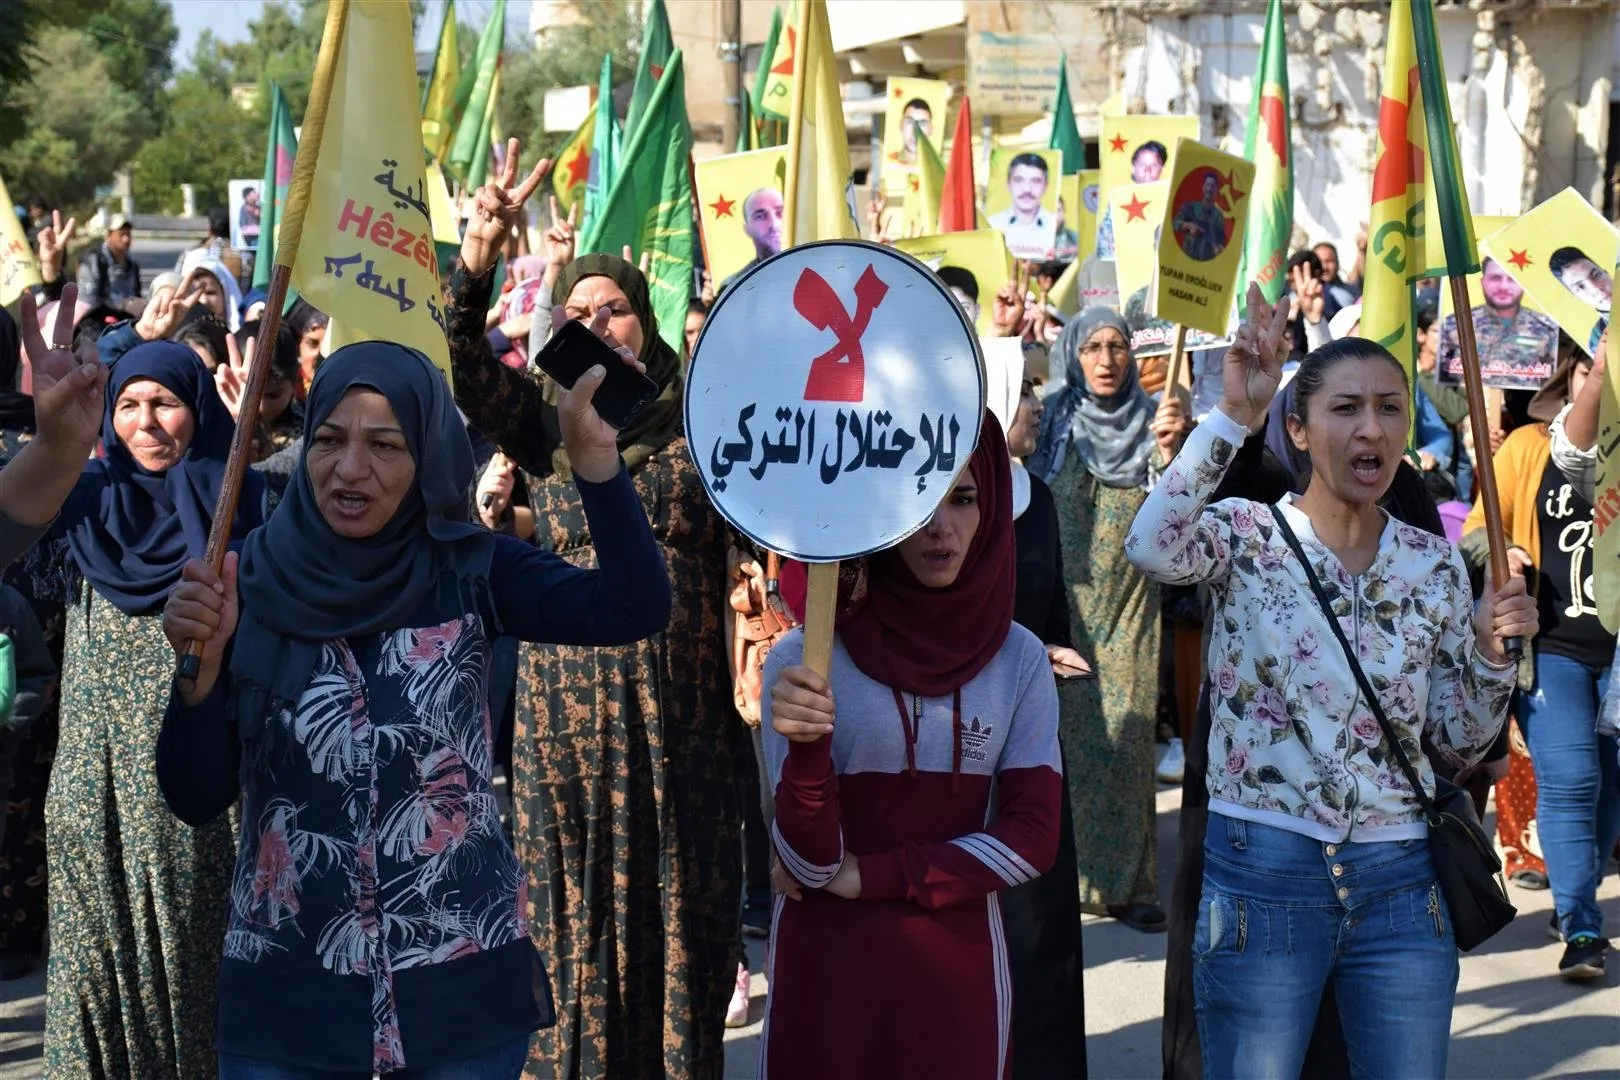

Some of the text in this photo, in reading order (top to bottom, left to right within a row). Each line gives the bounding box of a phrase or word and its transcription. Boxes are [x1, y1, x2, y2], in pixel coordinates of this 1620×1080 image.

[1168, 286, 1195, 302] HASAN
[793, 263, 890, 403] لا
[710, 402, 960, 495] للإحتلال التركي
[1545, 484, 1574, 519] it
[961, 748, 987, 762] didas
